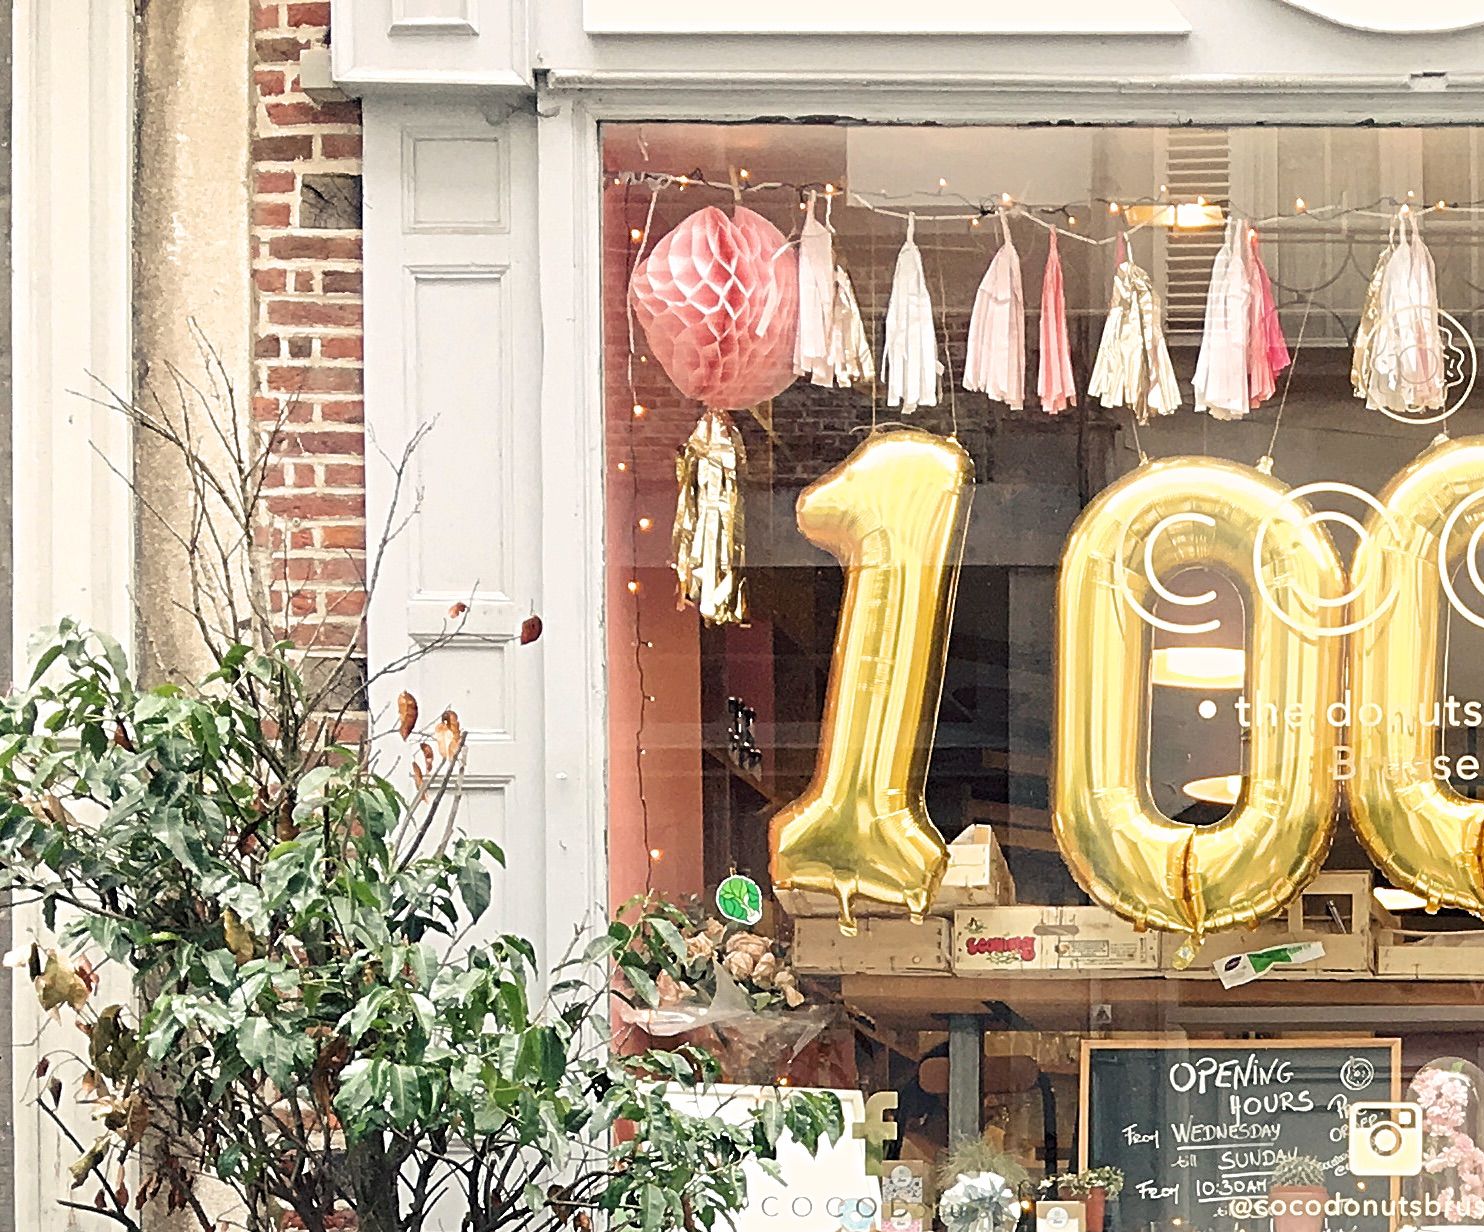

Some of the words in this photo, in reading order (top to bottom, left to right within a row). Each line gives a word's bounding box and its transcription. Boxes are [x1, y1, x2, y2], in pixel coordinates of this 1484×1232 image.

[1234, 689, 1309, 728] the
[1169, 1053, 1294, 1094] OPENING
[1229, 1090, 1314, 1127] HOURS
[1171, 1115, 1281, 1143] WEDNESDAY
